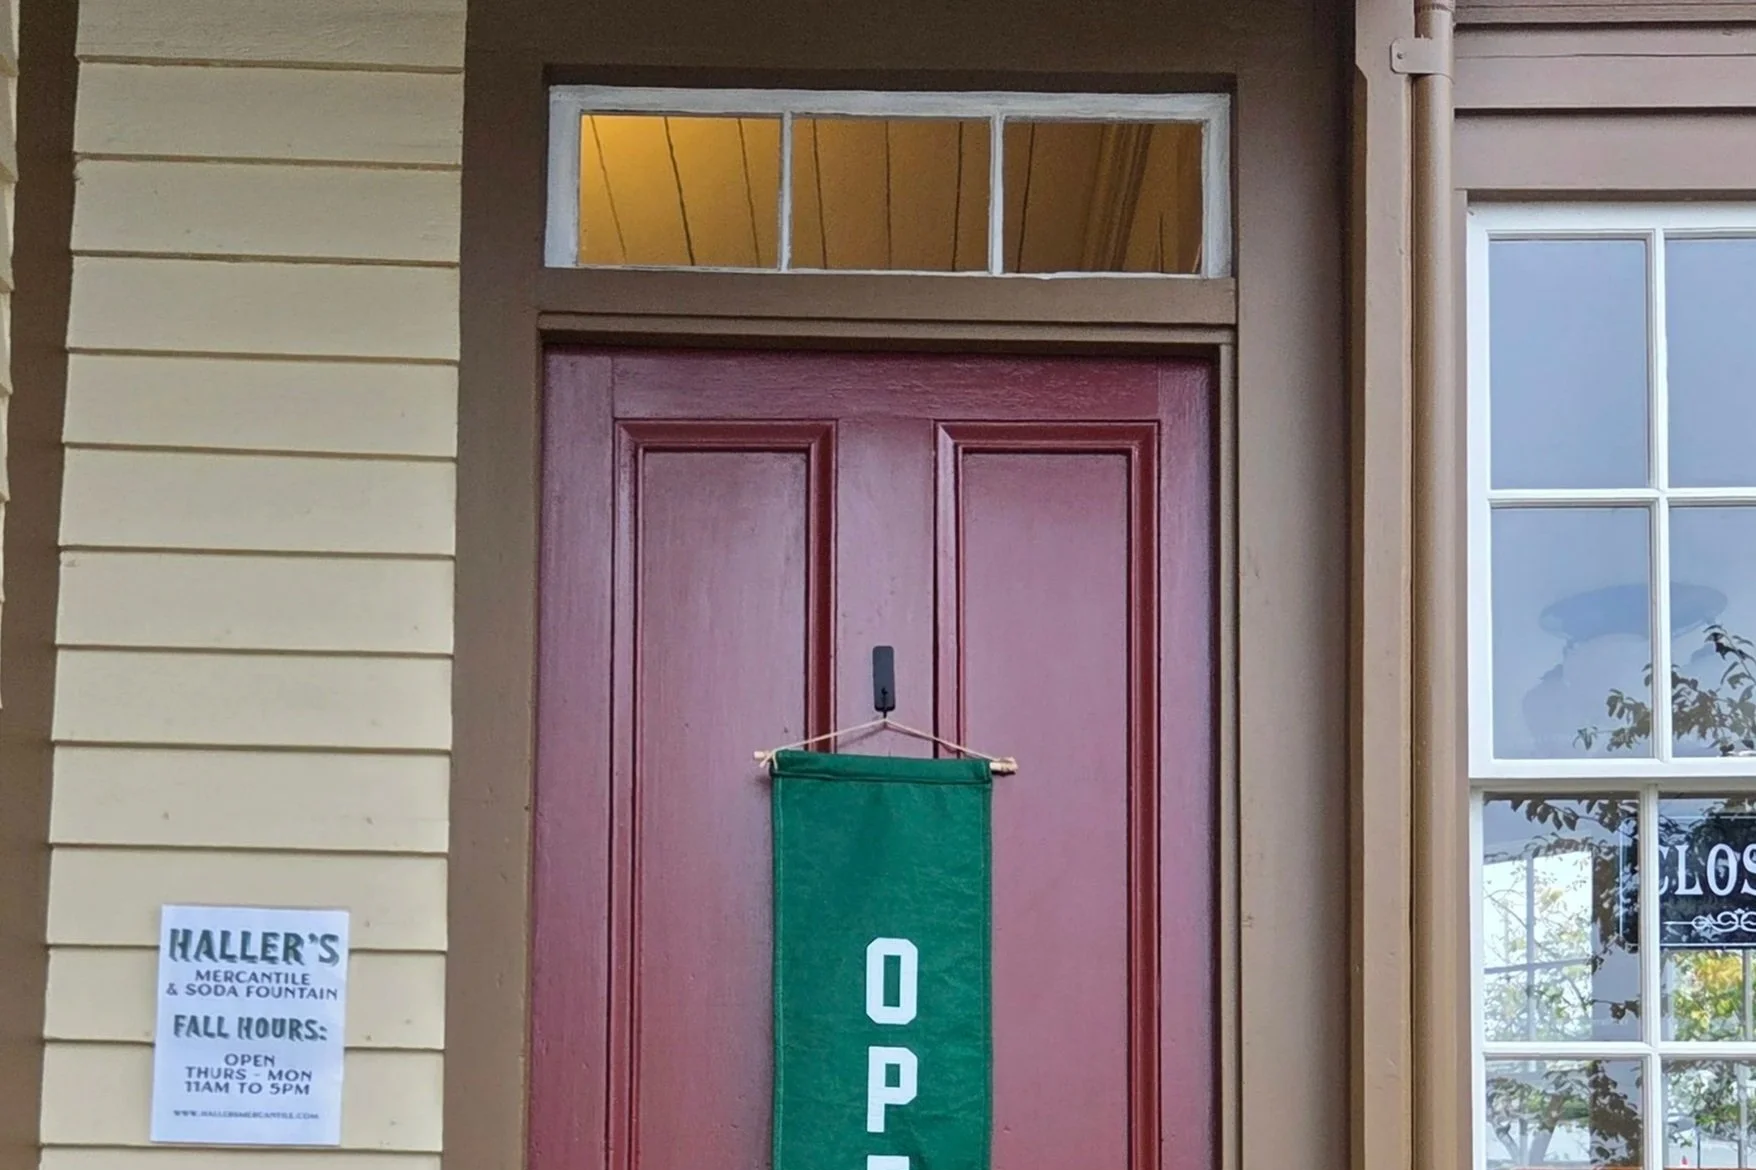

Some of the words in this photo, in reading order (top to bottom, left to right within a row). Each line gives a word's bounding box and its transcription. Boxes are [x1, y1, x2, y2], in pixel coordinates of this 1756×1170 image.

[169, 928, 340, 966] HALLER'S
[195, 969, 311, 986] MERCANTILE
[166, 983, 179, 996] &
[185, 983, 239, 997] SODA
[246, 985, 338, 1000] FOUNTAIN
[173, 1014, 230, 1039] FALL
[237, 1016, 328, 1042] HOURS:
[224, 1053, 275, 1067] OPEN
[186, 1066, 247, 1080] THURS
[267, 1069, 312, 1082] MON
[185, 1080, 230, 1094] 11AM
[238, 1082, 263, 1095] TO
[269, 1082, 310, 1096] 5PM
